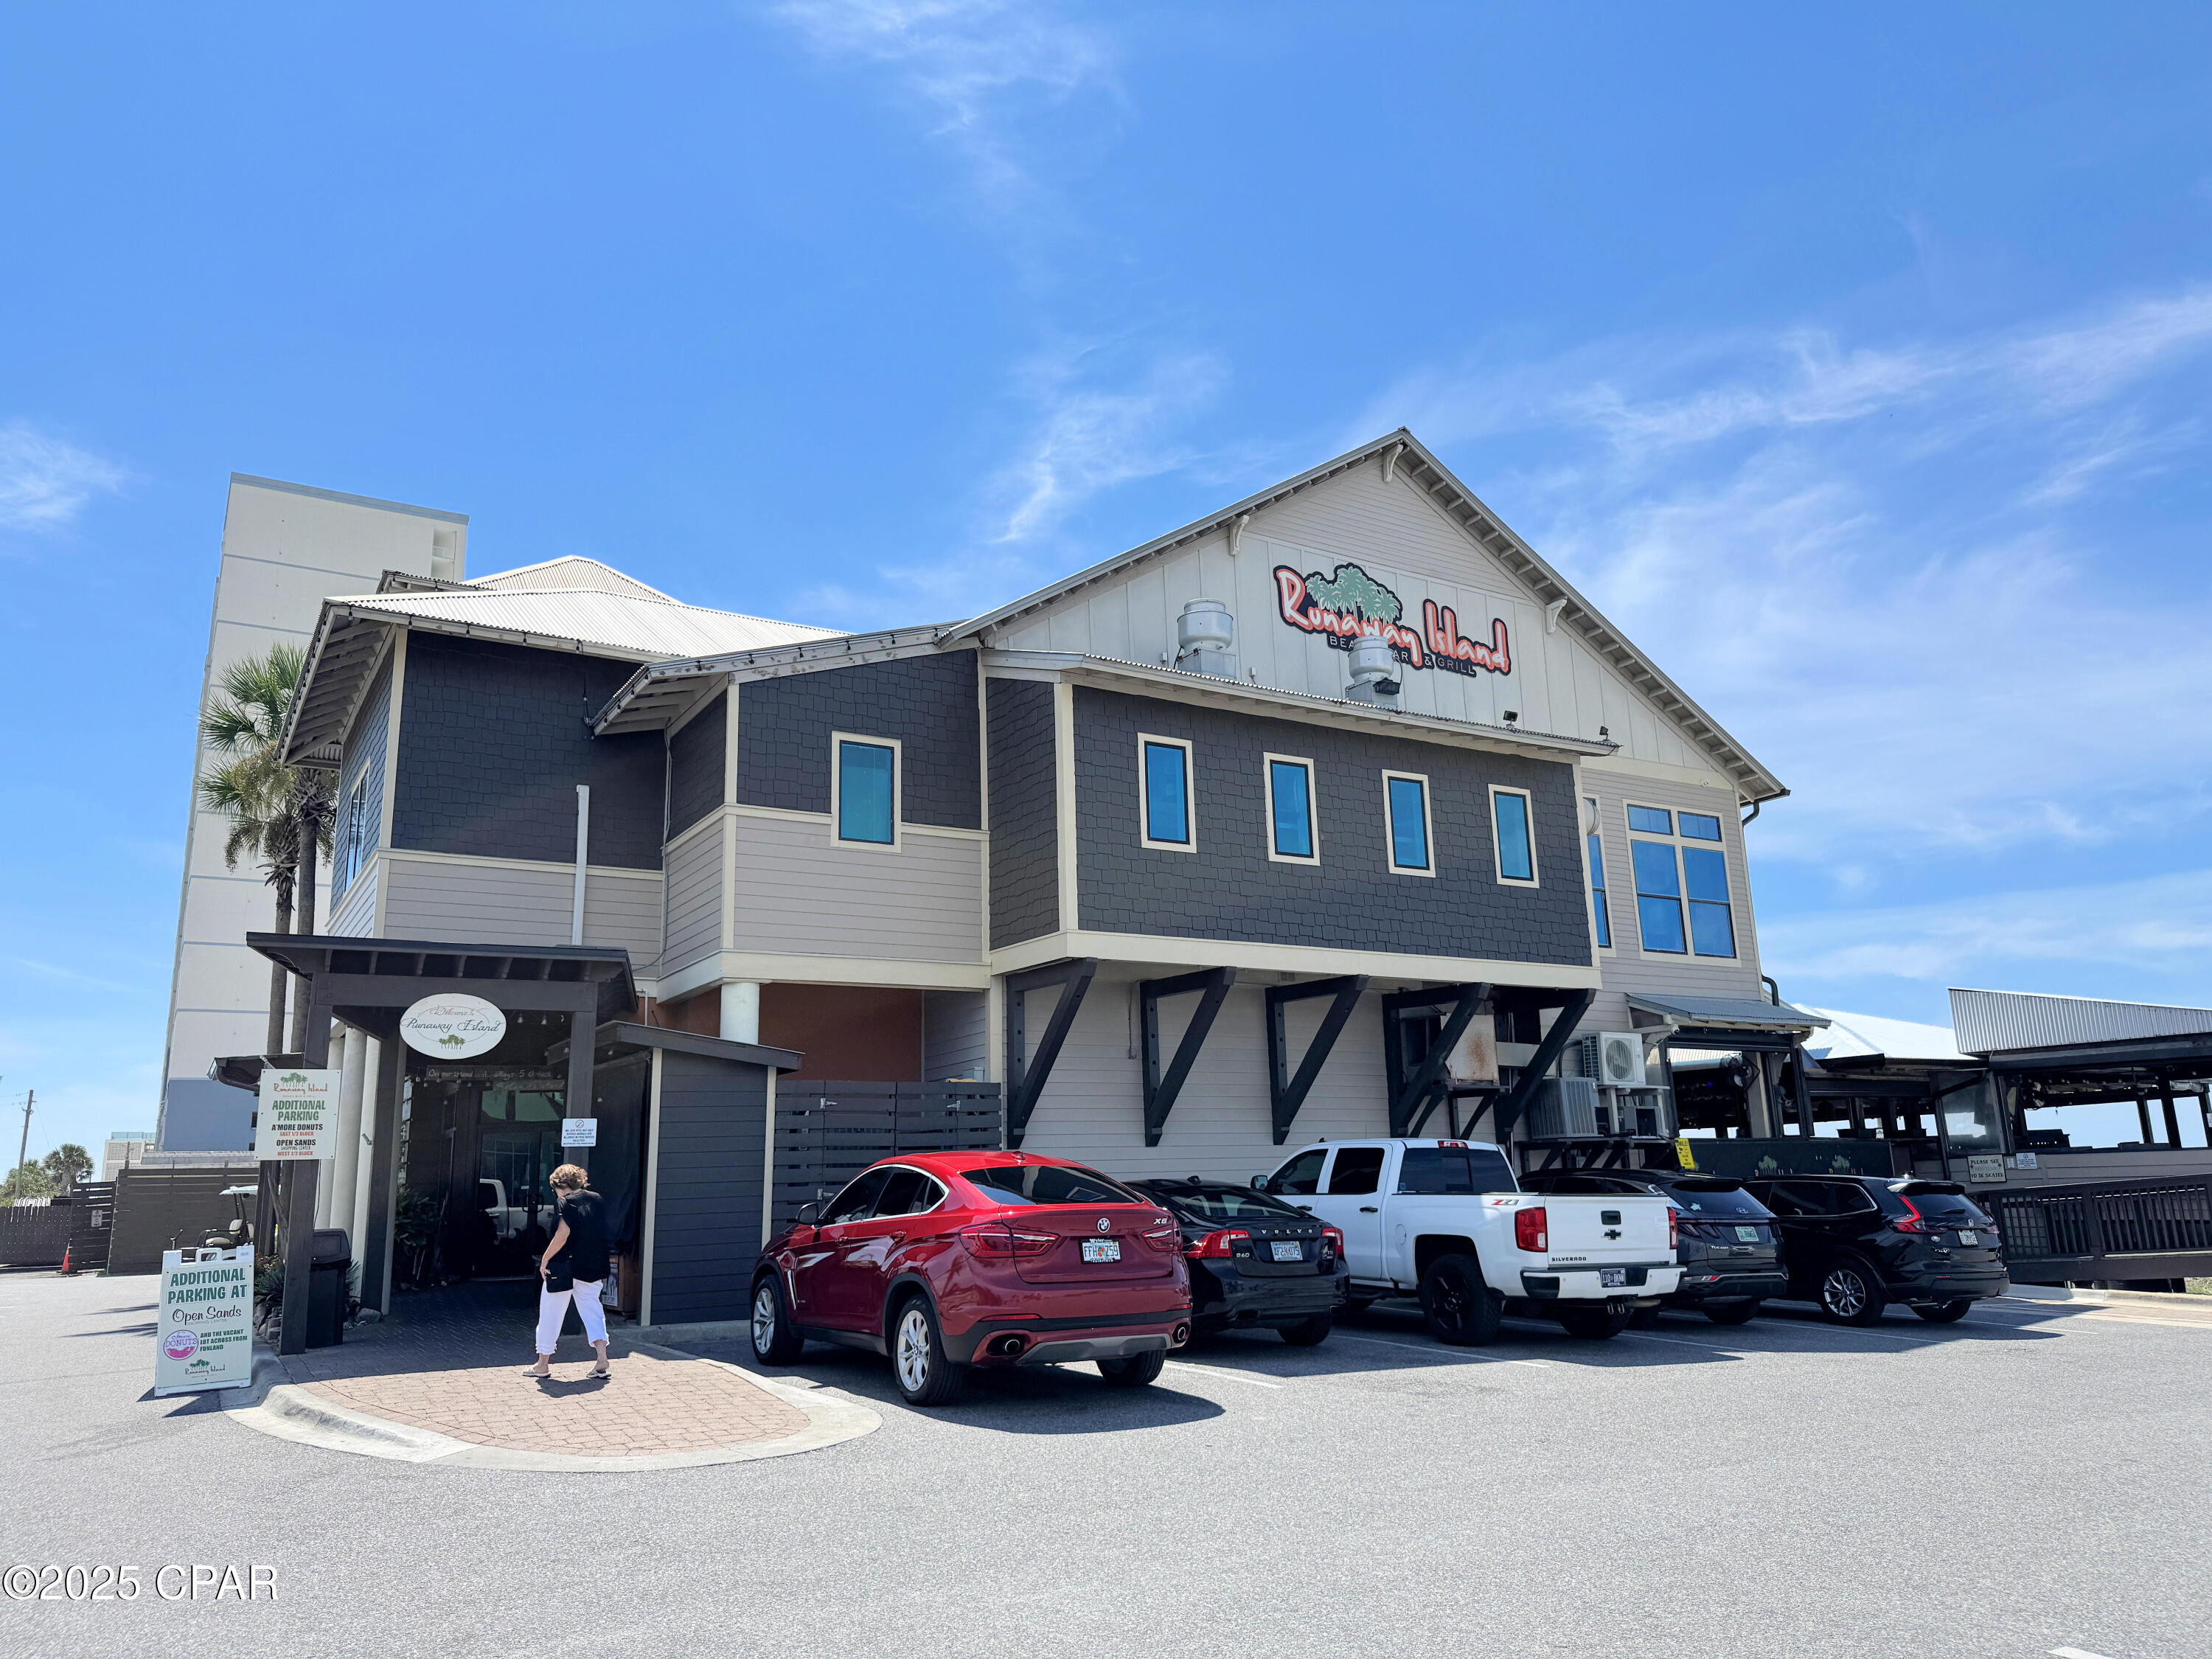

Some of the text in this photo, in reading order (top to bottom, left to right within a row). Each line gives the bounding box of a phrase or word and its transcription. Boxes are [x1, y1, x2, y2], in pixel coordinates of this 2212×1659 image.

[1276, 568, 1509, 673] Runaway Island
[1393, 650, 1408, 662] AR
[1425, 656, 1433, 666] &
[1439, 658, 1475, 675] GRILL
[430, 1005, 467, 1015] Welcome
[400, 1018, 505, 1033] Runaway Island
[274, 1082, 328, 1094] Runaway Island
[272, 1100, 326, 1110] ADDITIONAL
[277, 1110, 319, 1121] PARKING
[1084, 1245, 1097, 1257] FFH
[170, 1267, 246, 1287] ADDITIONAL
[167, 1284, 247, 1304] PARKING AT
[173, 1305, 241, 1325] Open Sands
[165, 1338, 198, 1347] DONUTS
